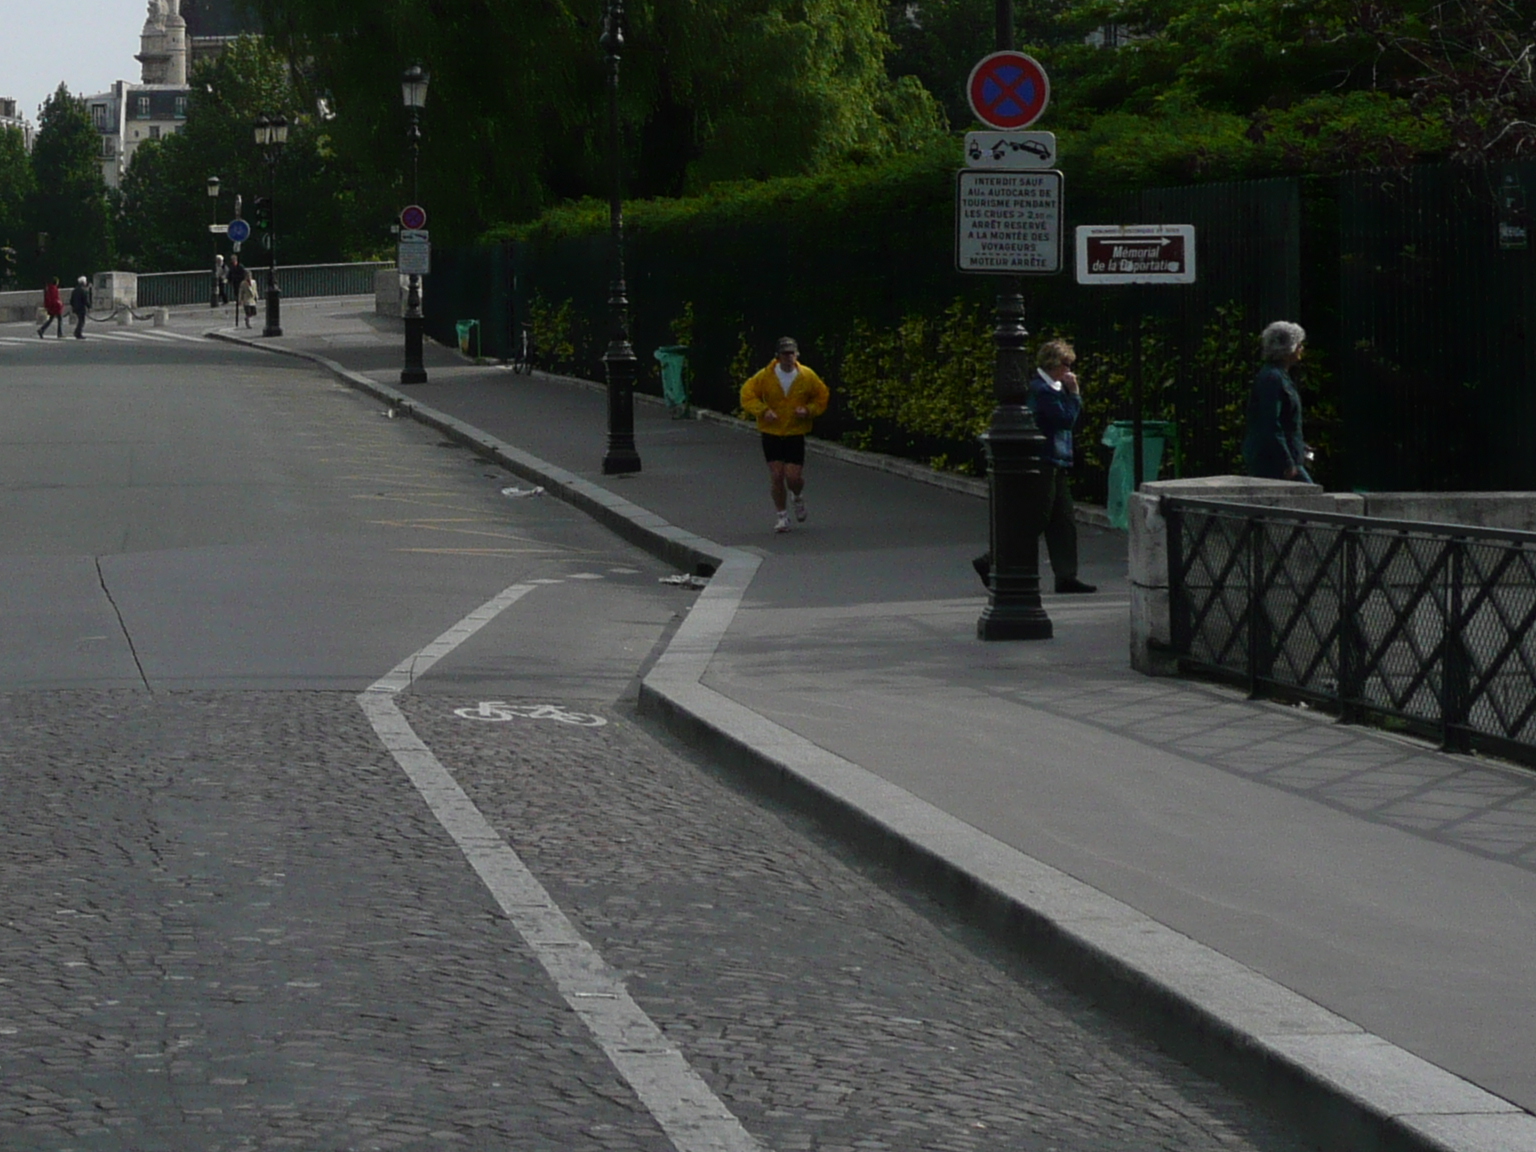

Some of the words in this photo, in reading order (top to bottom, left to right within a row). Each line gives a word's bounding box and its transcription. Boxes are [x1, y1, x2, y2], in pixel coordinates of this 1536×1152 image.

[975, 178, 1017, 186] INTERDIT
[1019, 178, 1044, 186] SAUF
[988, 189, 1036, 197] AUTOCARS
[1039, 189, 1052, 198] DE
[963, 199, 1011, 207] TOURISME
[1013, 200, 1056, 208] PENDANT
[965, 210, 981, 218] LES
[984, 210, 1014, 218] CRUES
[972, 219, 1001, 228] ARRÊT
[990, 231, 1029, 241] MONTÉE
[1031, 233, 1049, 241] DES
[980, 242, 1037, 251] VOYAGEURS
[1112, 245, 1160, 258] Mémorial
[970, 257, 1009, 266] MOTEUR
[1092, 260, 1105, 271] de
[1108, 259, 1116, 271] la
[1120, 259, 1179, 273] Dportati
